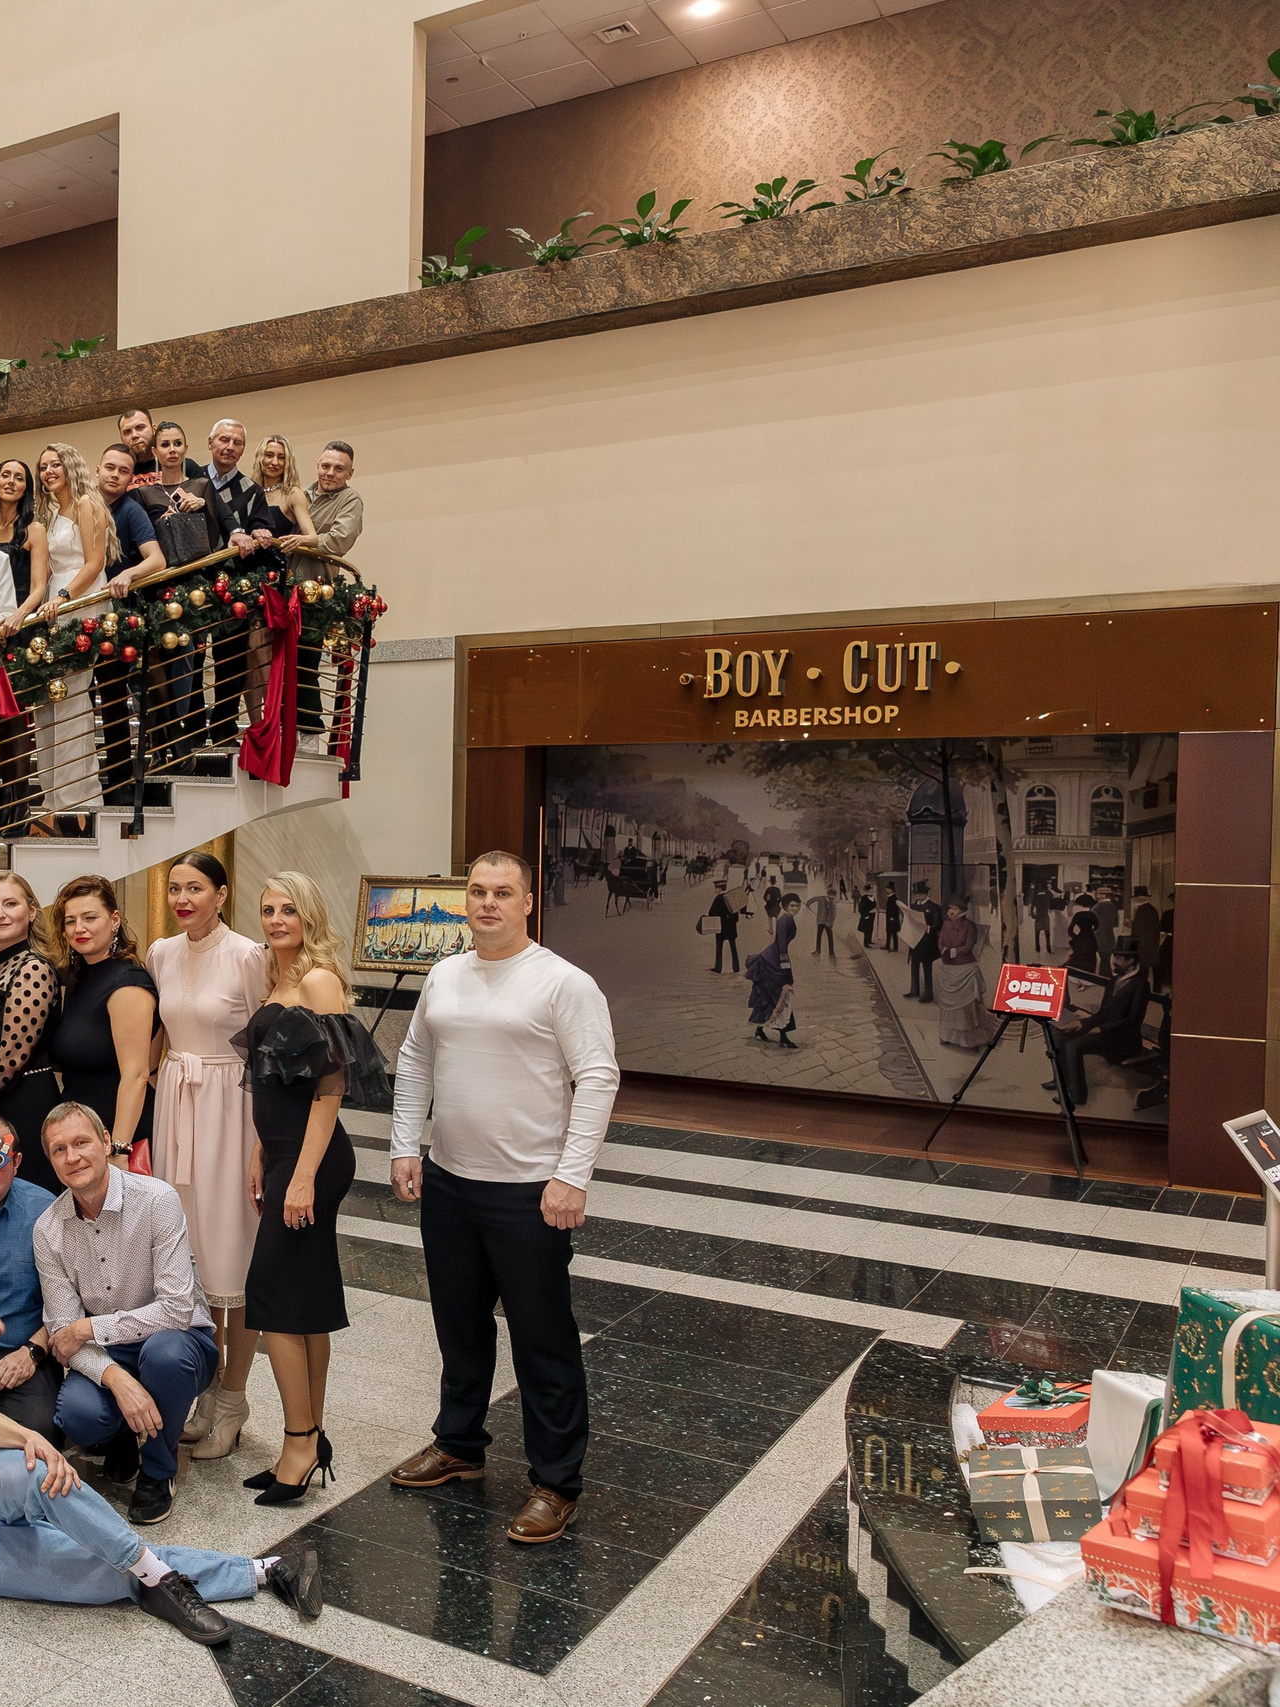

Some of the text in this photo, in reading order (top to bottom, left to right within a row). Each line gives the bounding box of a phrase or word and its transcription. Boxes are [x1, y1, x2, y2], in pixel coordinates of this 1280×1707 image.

[703, 640, 938, 698] BOY CUT
[734, 705, 900, 728] BARBERSHOP
[1008, 980, 1054, 996] OPEN
